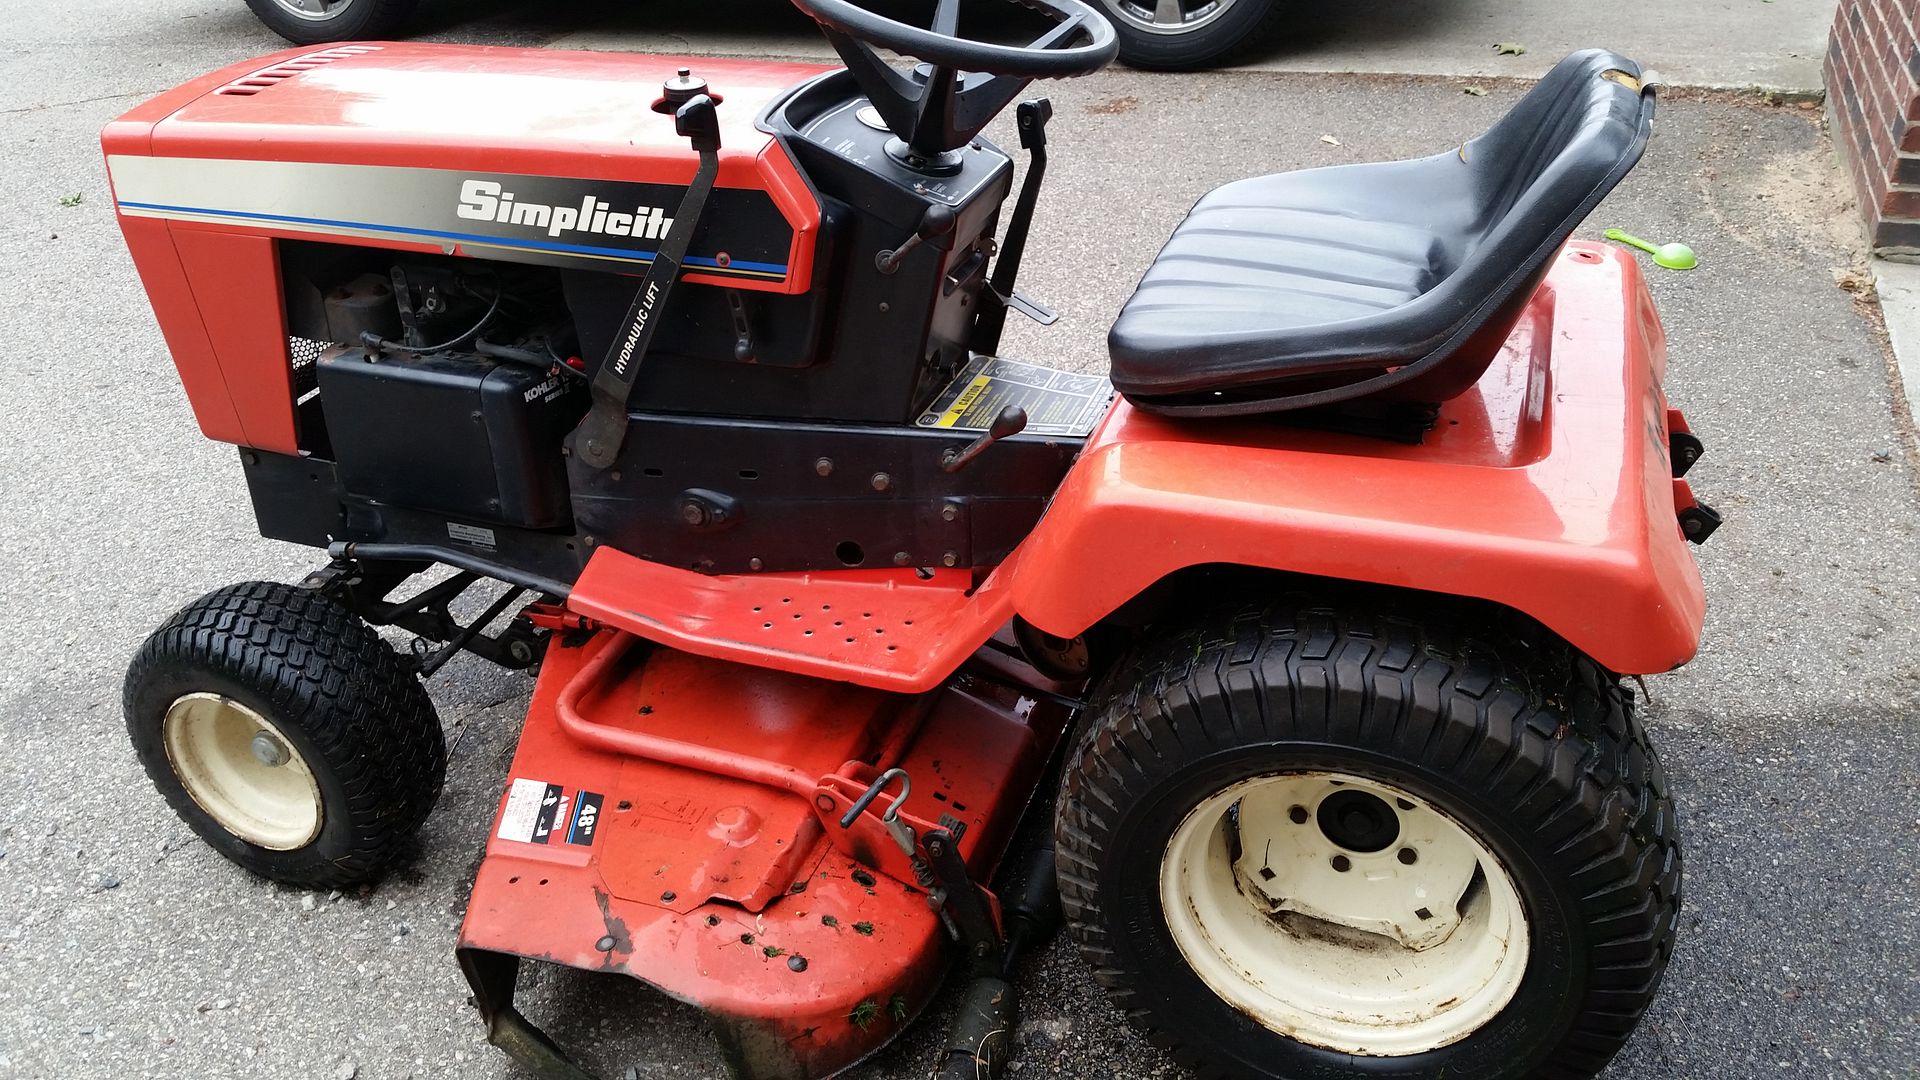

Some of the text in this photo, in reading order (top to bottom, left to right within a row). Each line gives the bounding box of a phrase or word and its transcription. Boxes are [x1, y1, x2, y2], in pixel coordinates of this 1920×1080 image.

[614, 281, 660, 375] HYDRAULIC LIFT
[524, 377, 559, 402] KOHLER
[578, 804, 597, 835] 48"
